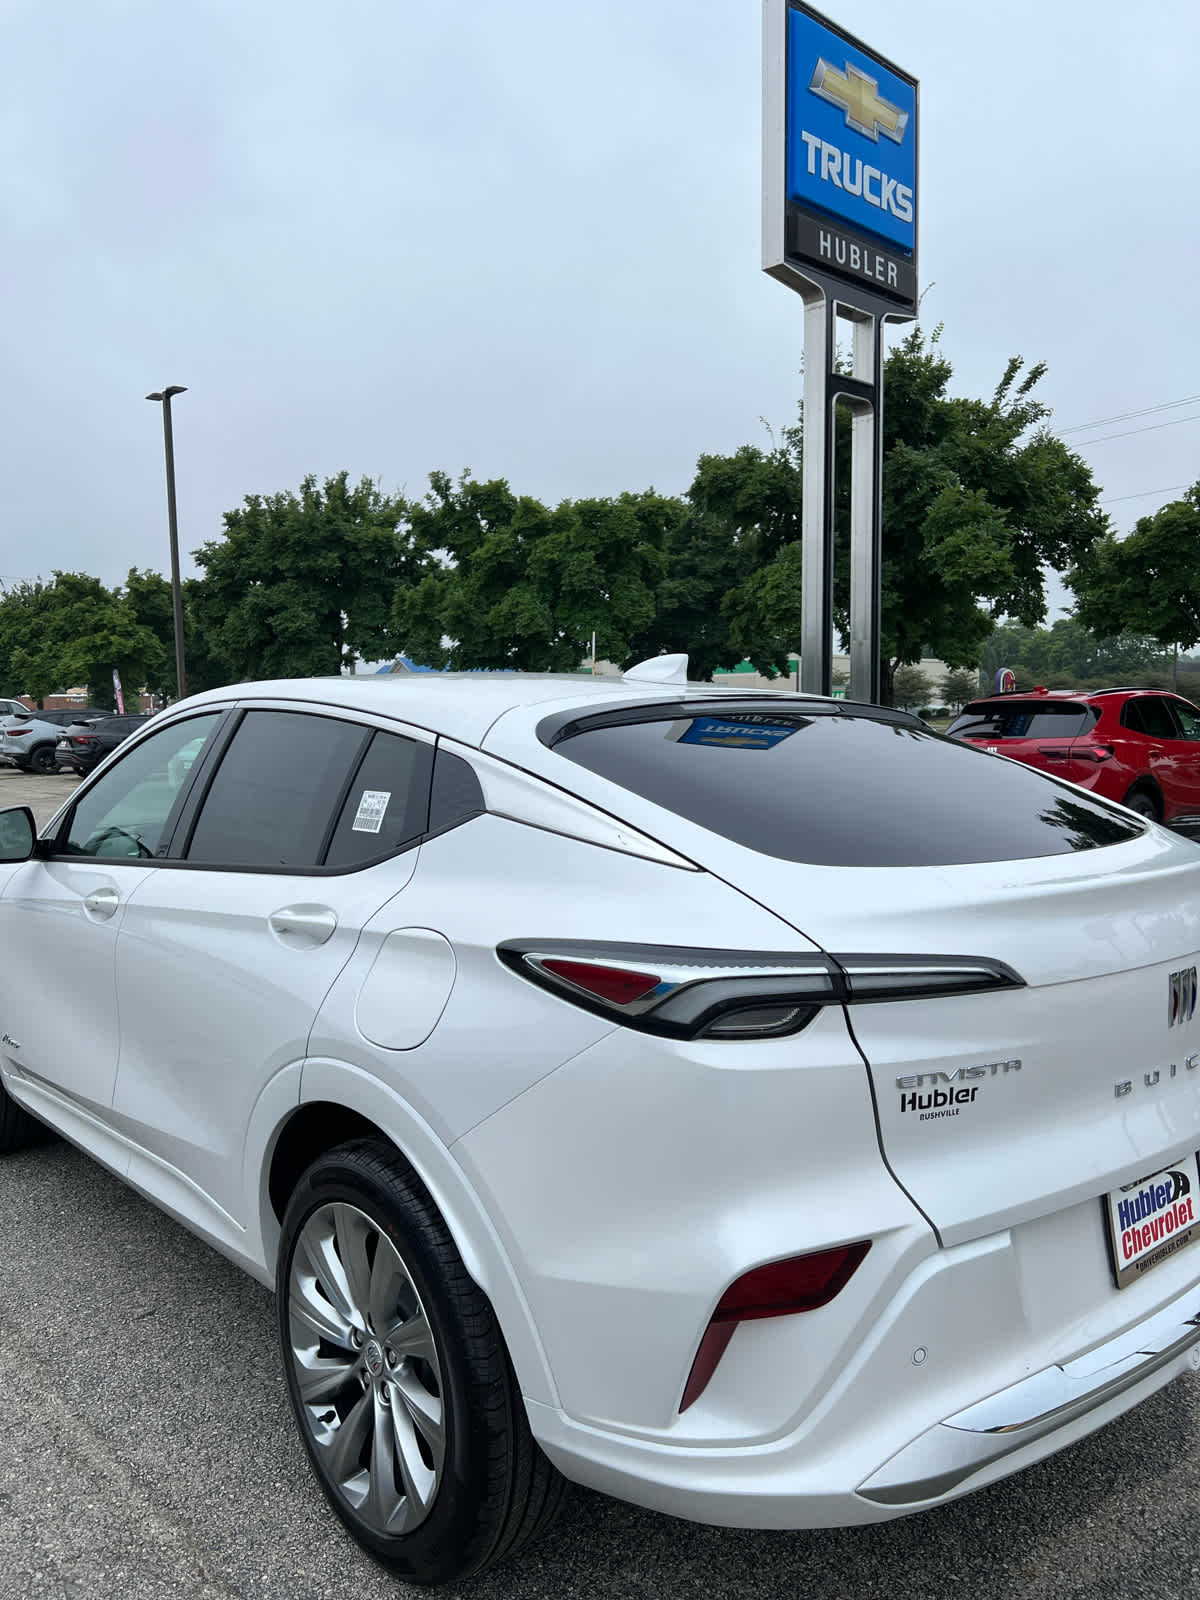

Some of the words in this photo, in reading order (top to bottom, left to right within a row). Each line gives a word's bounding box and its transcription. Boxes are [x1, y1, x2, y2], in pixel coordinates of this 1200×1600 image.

[801, 130, 913, 223] TRUCKS
[819, 230, 898, 288] HUBLER
[896, 1059, 1022, 1089] ENVISTA
[901, 1087, 979, 1112] Hubler
[920, 1108, 960, 1121] RUSHVILLE
[1117, 1179, 1174, 1232] Hubler
[1122, 1197, 1194, 1260] Chevrolet
